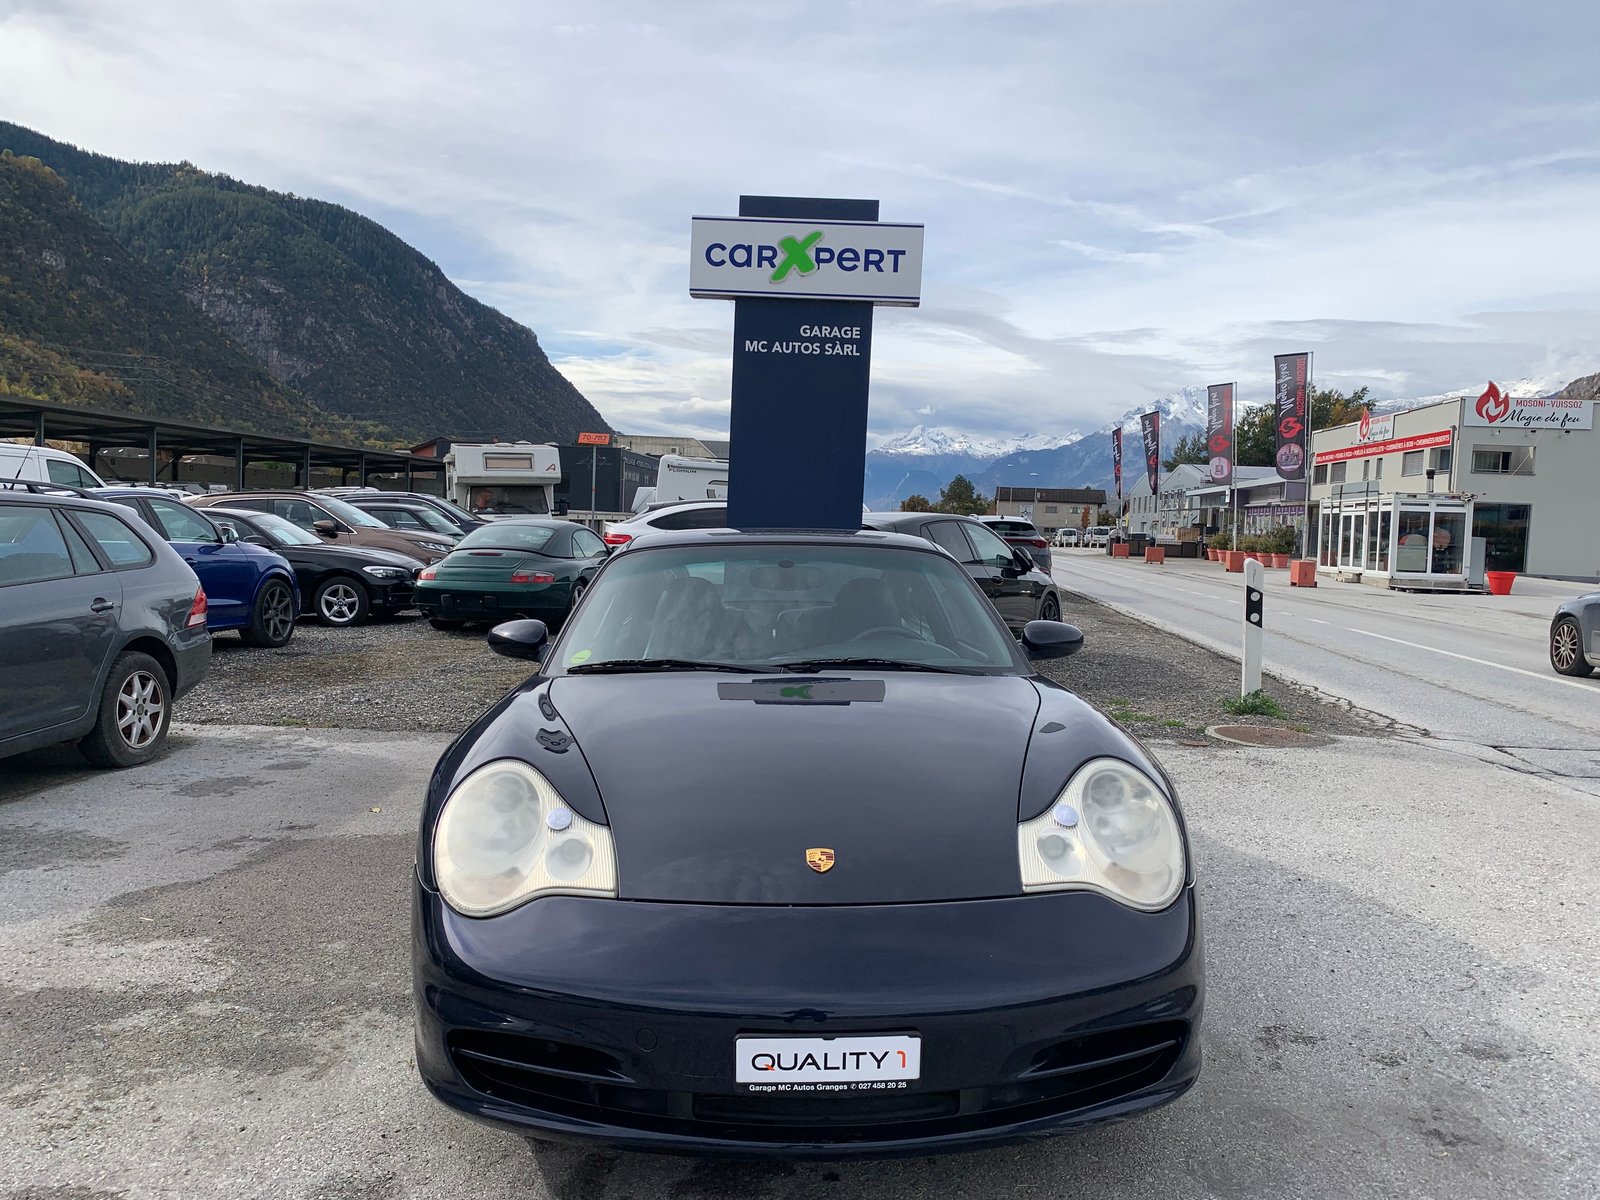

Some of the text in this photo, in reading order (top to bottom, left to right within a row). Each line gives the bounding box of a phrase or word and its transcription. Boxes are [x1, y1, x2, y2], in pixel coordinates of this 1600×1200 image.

[800, 325, 860, 339] GARAGE
[745, 340, 860, 356] MC AUTOS SÀRL
[1516, 399, 1583, 408] MOSONI-VUISSOZ
[1500, 409, 1580, 428] Magie du feu
[751, 1050, 907, 1071] QUALITY 1
[749, 1084, 776, 1092] Garage
[778, 1083, 791, 1091] MC
[793, 1083, 815, 1091] Autos
[816, 1082, 847, 1091] Granges
[858, 1082, 871, 1090] 027
[887, 1081, 896, 1089] 20
[897, 1081, 907, 1089] 25
